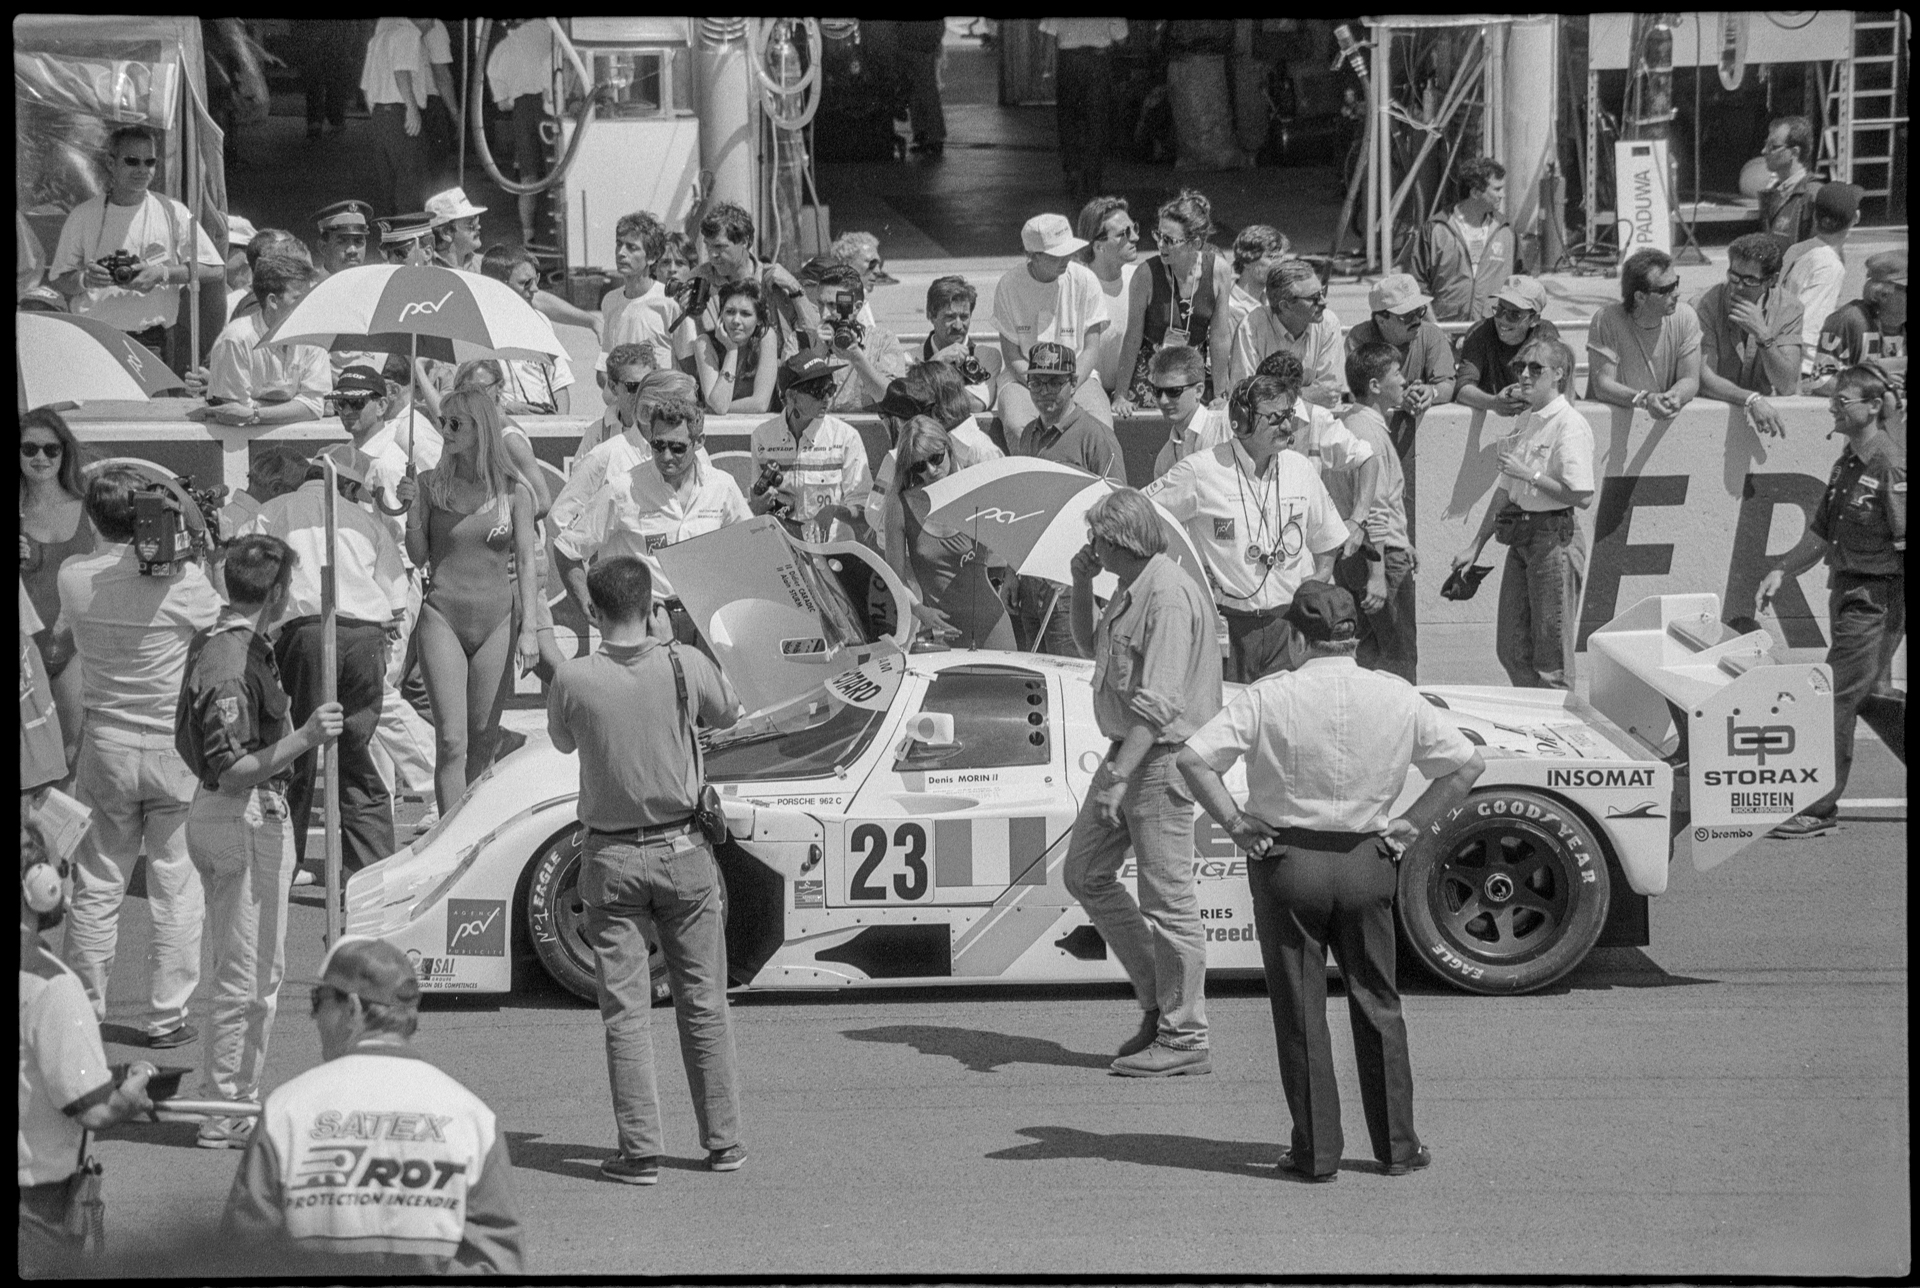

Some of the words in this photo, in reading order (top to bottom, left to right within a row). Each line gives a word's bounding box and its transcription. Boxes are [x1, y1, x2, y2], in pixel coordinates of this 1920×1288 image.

[1633, 170, 1653, 243] PADUWA
[960, 550, 976, 568] pc
[928, 776, 954, 785] Denis
[958, 774, 990, 783] MORIN
[1547, 769, 1656, 787] INSOMAT
[1704, 767, 1819, 787] STORAX
[777, 797, 815, 806] PORSCHE
[820, 797, 834, 805] 962
[836, 797, 842, 805] C
[1731, 792, 1794, 807] BILSTEIN
[1477, 800, 1597, 885] GOODYEAR
[1711, 829, 1754, 840] brembo
[850, 822, 929, 901] 23
[533, 850, 562, 909] EAGLE
[1200, 908, 1234, 920] RIES
[1202, 923, 1260, 942] reed
[434, 957, 456, 974] SAI
[1432, 943, 1485, 979] EAGLE
[309, 1109, 454, 1144] SATEX
[285, 1192, 384, 1209] PROTECTION
[386, 1193, 460, 1210] INCENDIE
